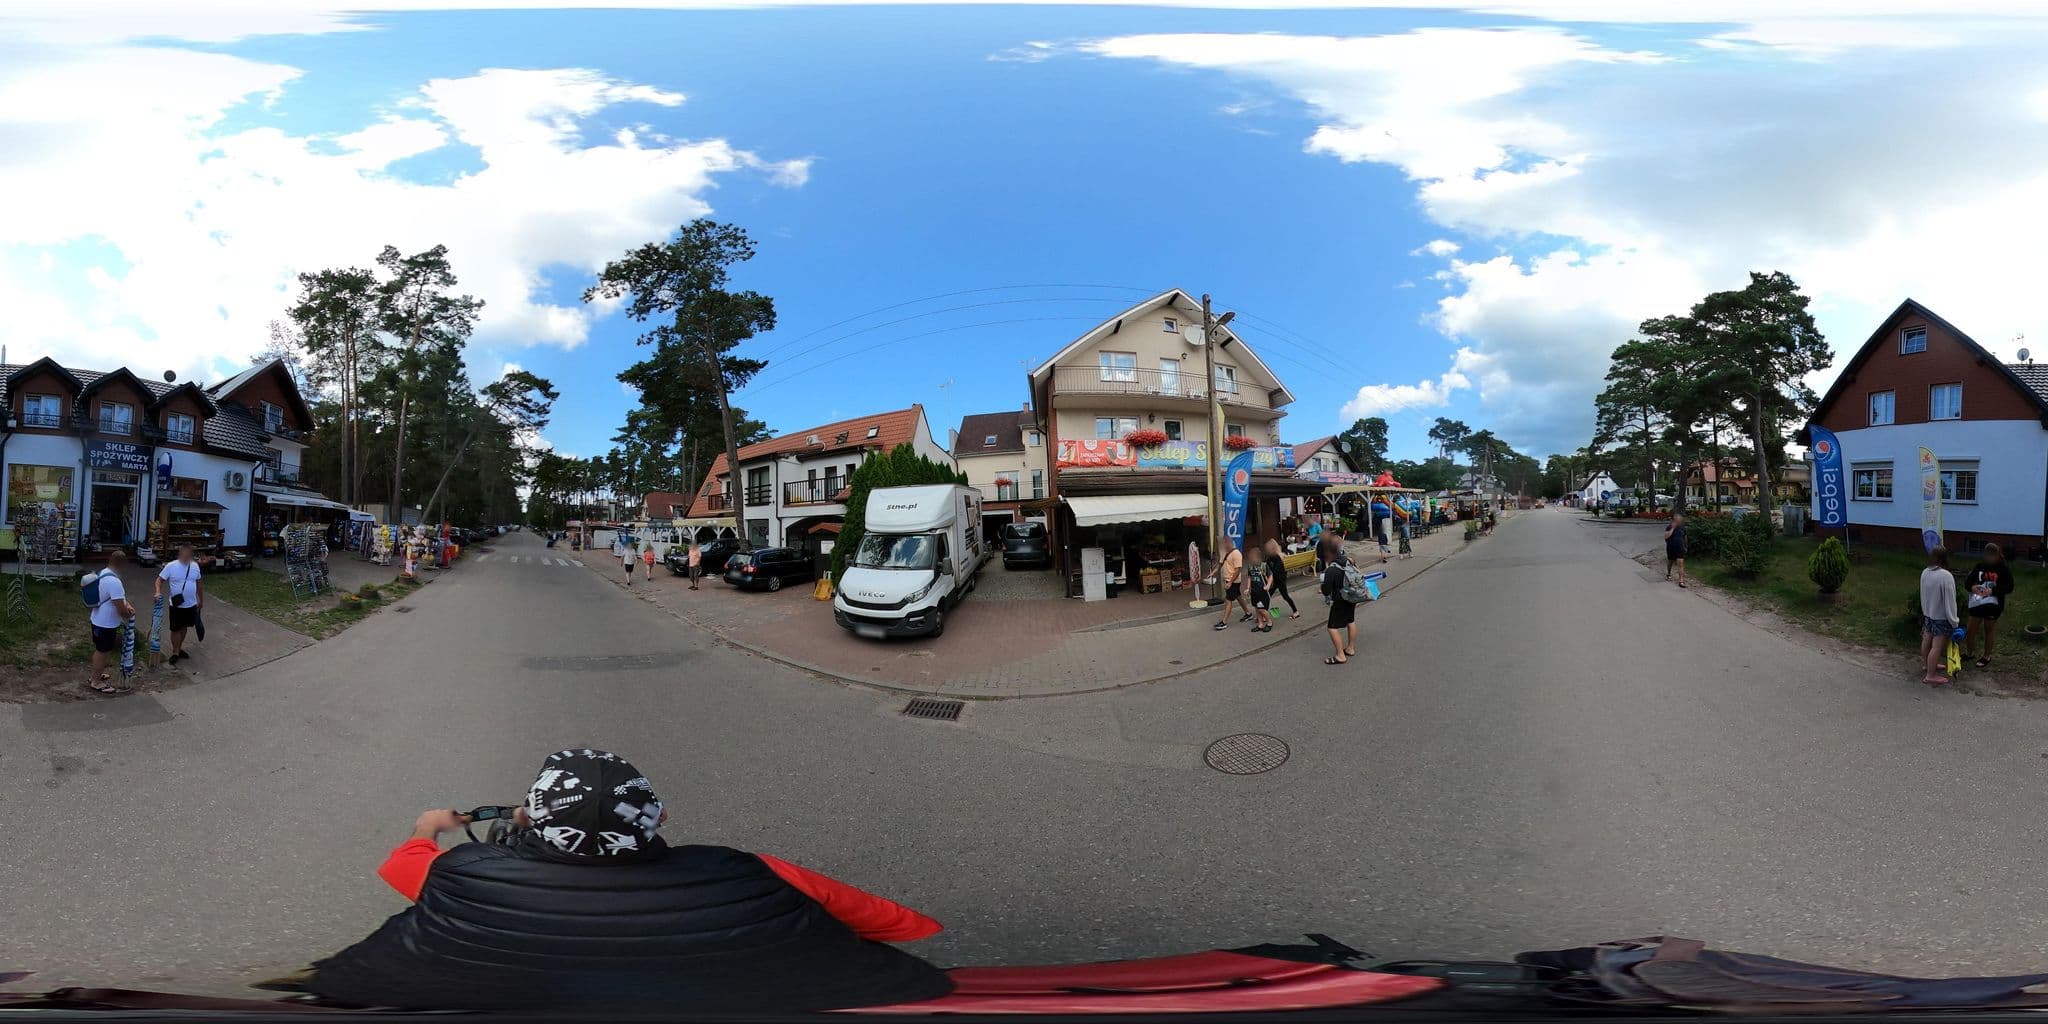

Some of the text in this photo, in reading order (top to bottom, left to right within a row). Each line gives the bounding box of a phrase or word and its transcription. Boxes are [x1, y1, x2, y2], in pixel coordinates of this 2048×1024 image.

[105, 442, 136, 453] SKLEP
[1141, 443, 1190, 465] Sklep
[121, 462, 148, 471] MARTA
